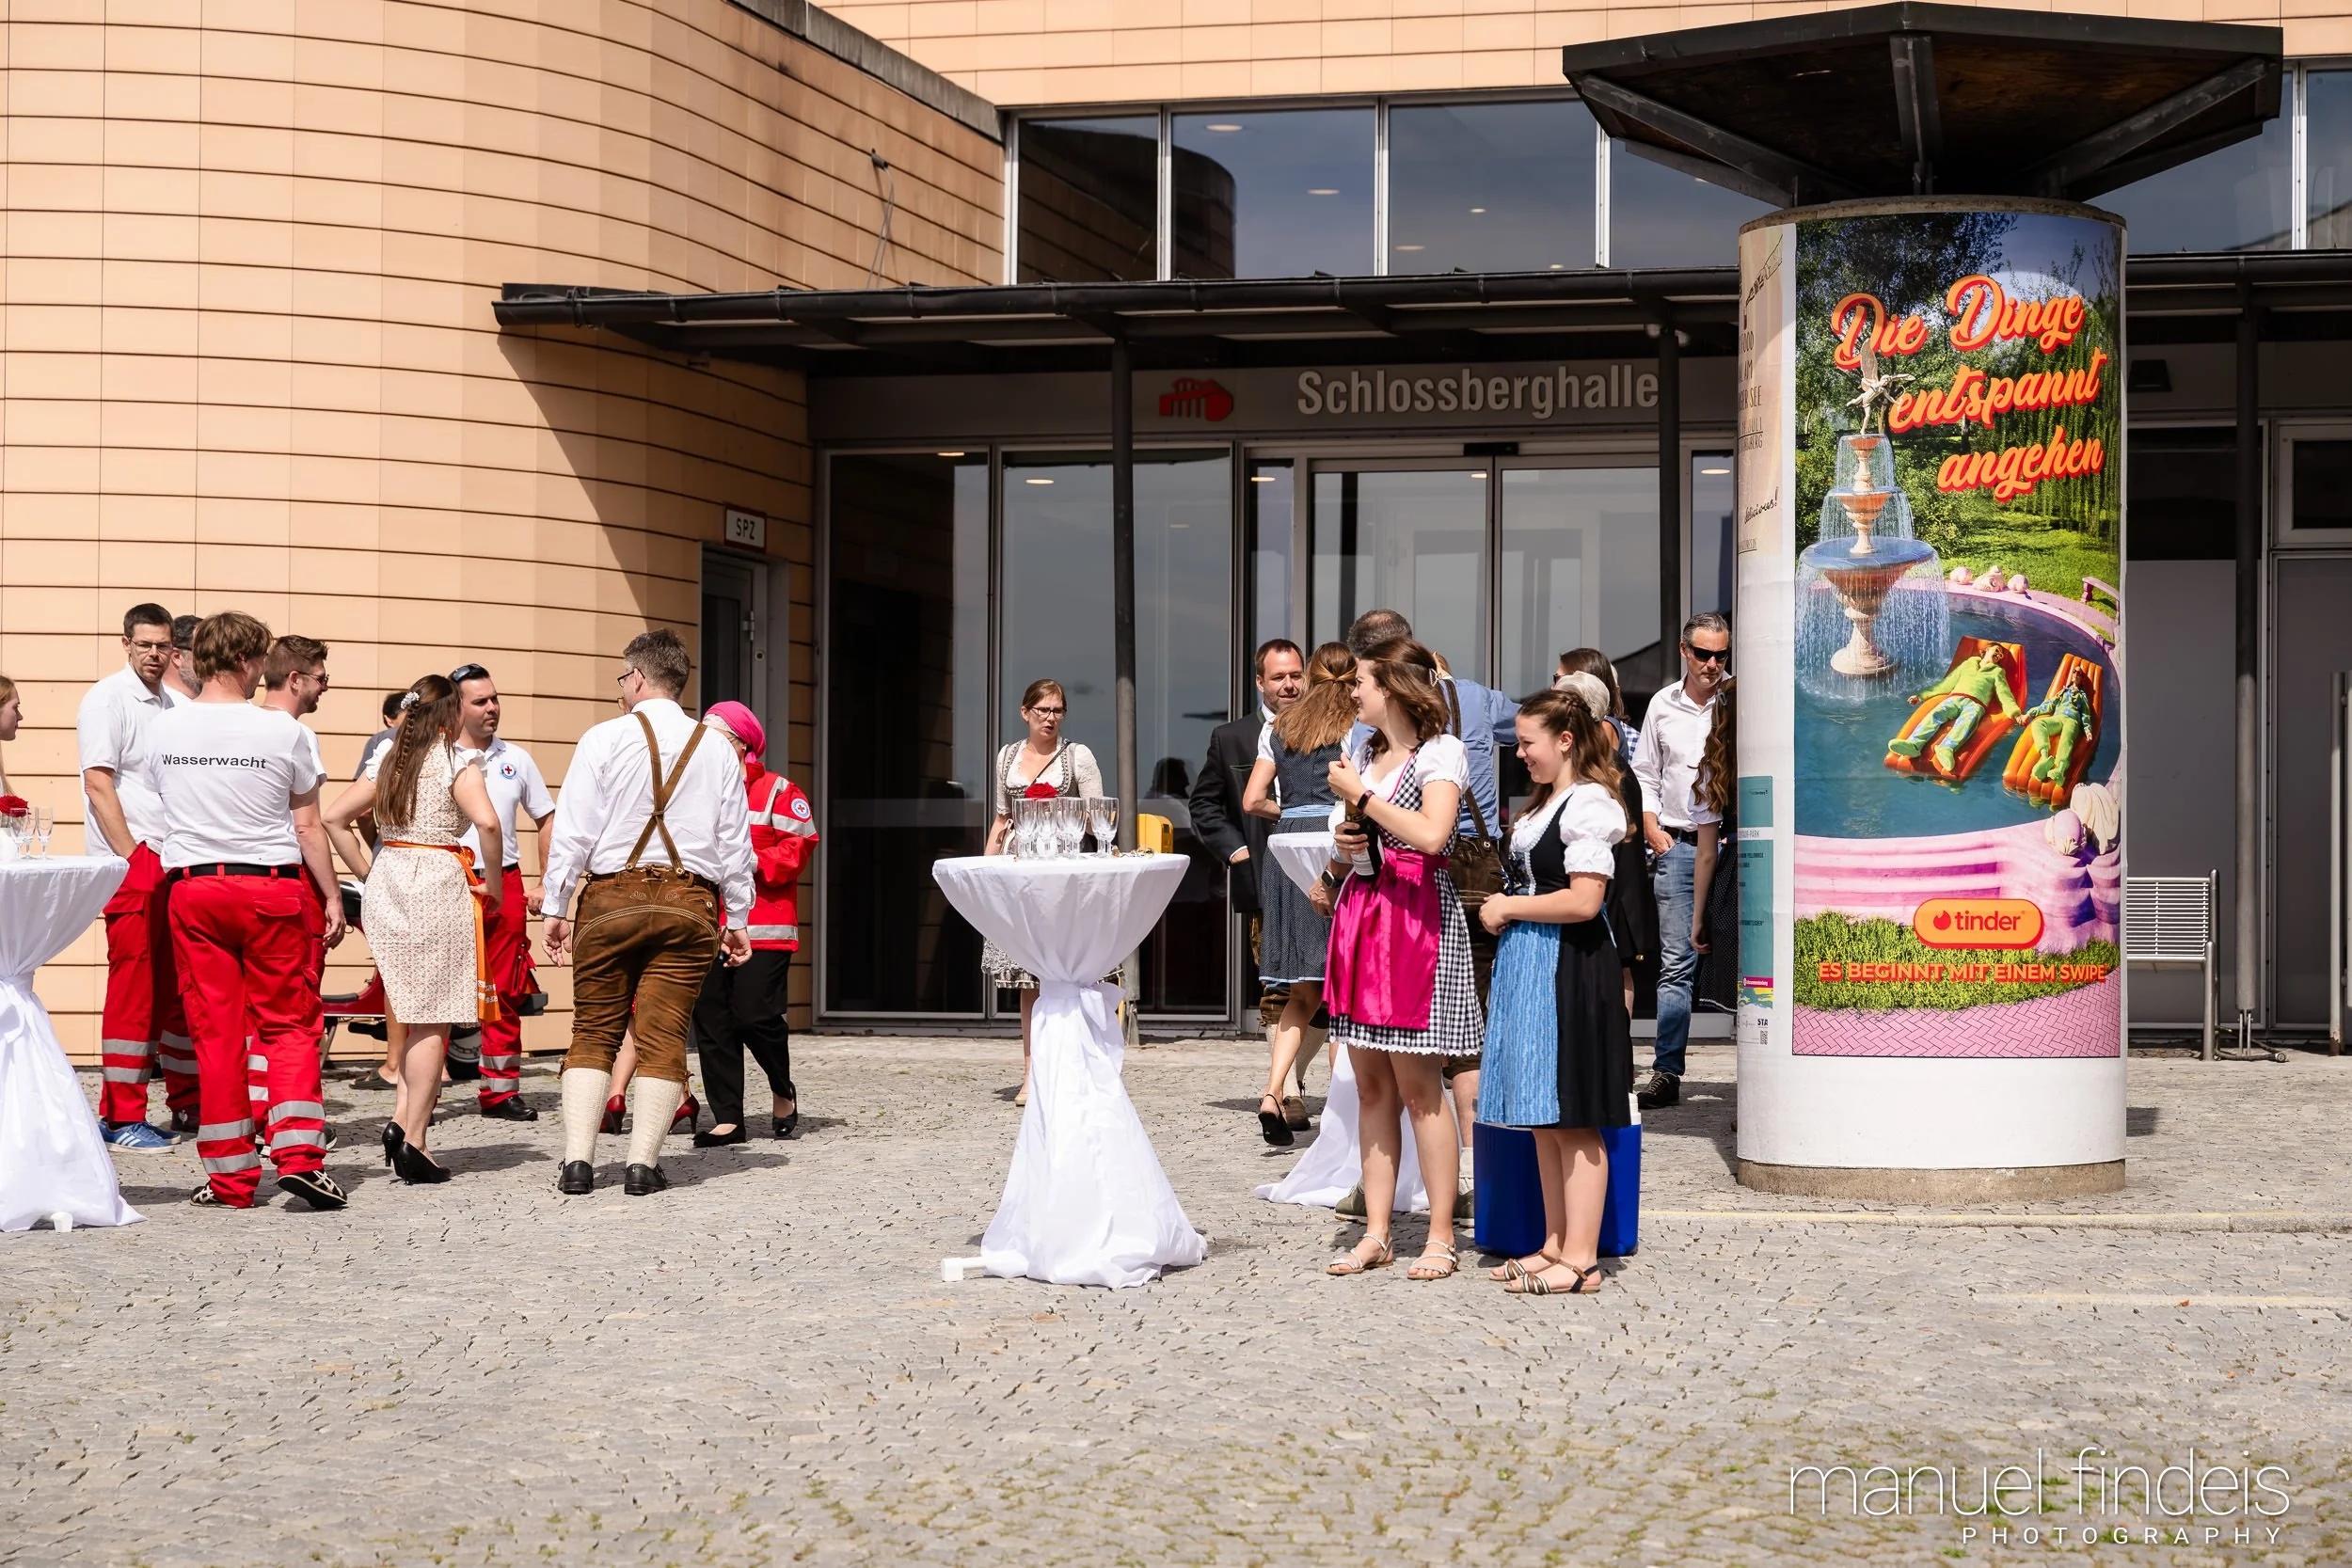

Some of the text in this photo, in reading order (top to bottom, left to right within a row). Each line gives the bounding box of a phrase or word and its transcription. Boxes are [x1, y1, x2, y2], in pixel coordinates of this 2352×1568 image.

[1830, 275, 2086, 370] Die Dinge
[1297, 365, 1659, 420] Schlossberghalle
[1888, 347, 2108, 434] entspannt
[1937, 425, 2106, 502] angehen
[736, 517, 755, 540] SPZ
[162, 754, 266, 769] Wasserwacht
[1954, 910, 2021, 930] tinder
[1819, 962, 1843, 982] ES
[1847, 962, 1947, 982] BEGINNT
[1948, 962, 1990, 982] MIT
[1994, 962, 2056, 982] EINEM
